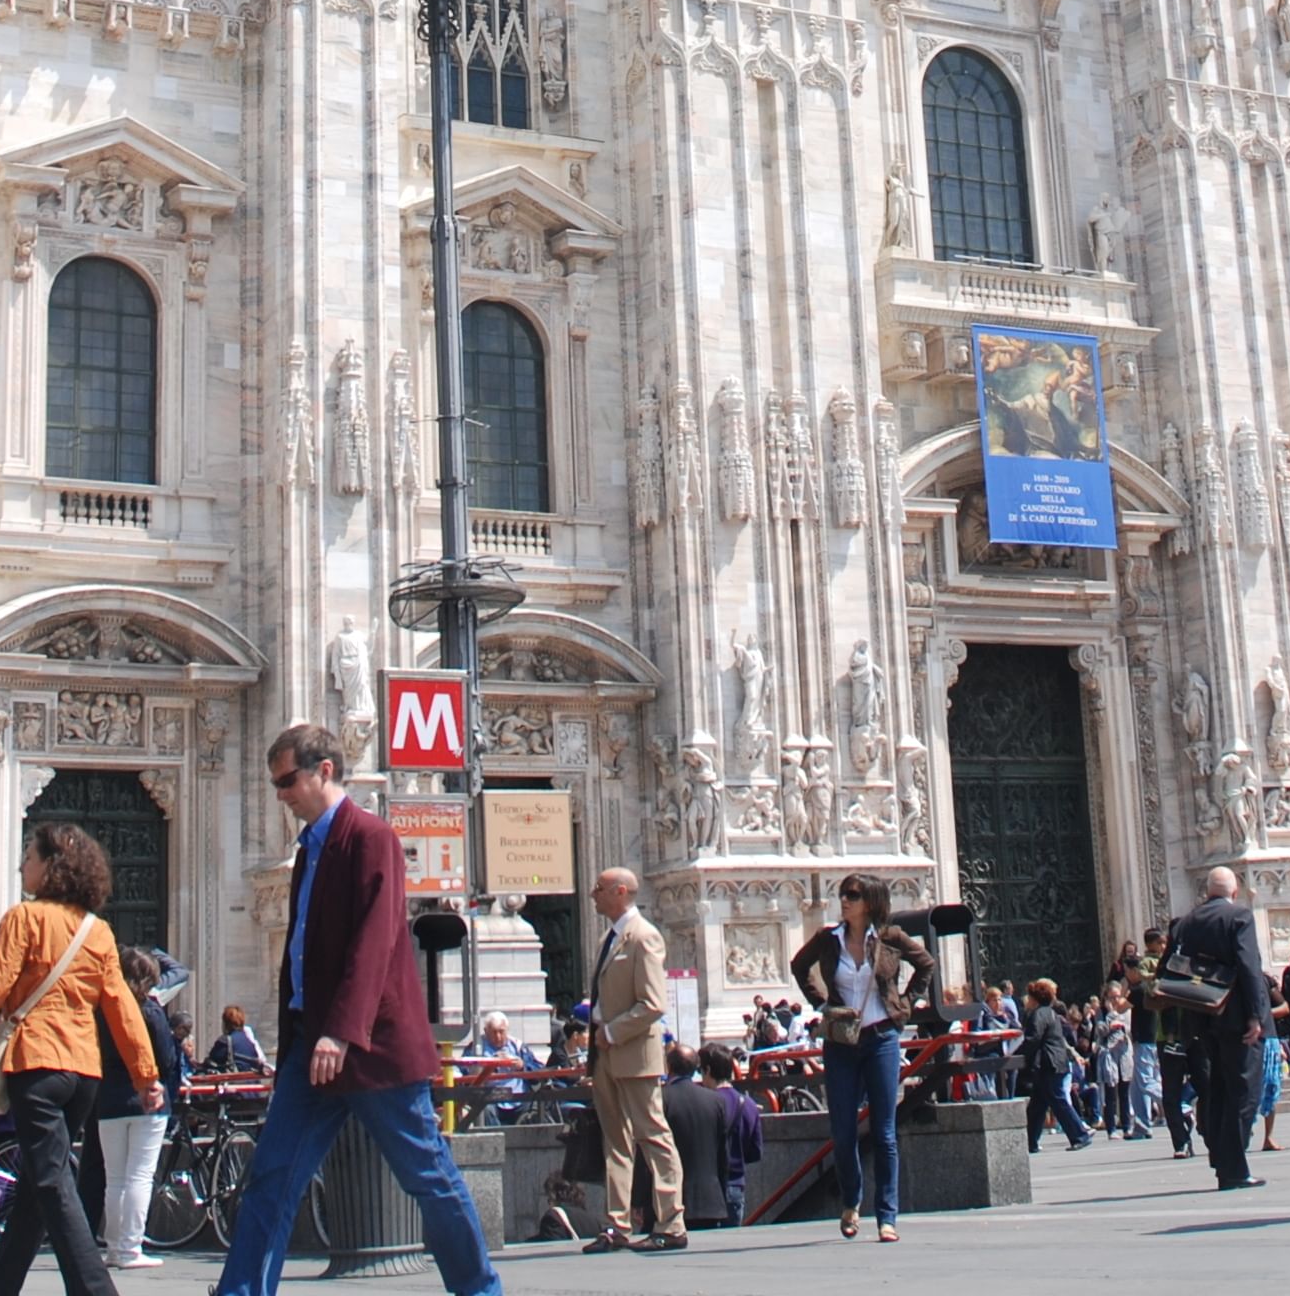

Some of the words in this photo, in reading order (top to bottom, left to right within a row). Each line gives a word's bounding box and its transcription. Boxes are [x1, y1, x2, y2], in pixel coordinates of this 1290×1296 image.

[1022, 483, 1031, 492] IV
[1034, 484, 1081, 495] CENTENARIO
[1040, 494, 1066, 504] DELLA
[1020, 503, 1085, 516] CANONIZZAZIONE
[1008, 513, 1018, 522] DI
[1029, 515, 1055, 524] CARLO
[391, 691, 461, 751] M
[492, 802, 523, 814] TEATRO
[534, 803, 563, 814] SCALA
[391, 815, 422, 828] ATM
[422, 814, 463, 828] POINT
[500, 836, 559, 847] BIGLIETTERIA
[506, 852, 552, 862] CENTRALE
[498, 874, 529, 885] TICKET
